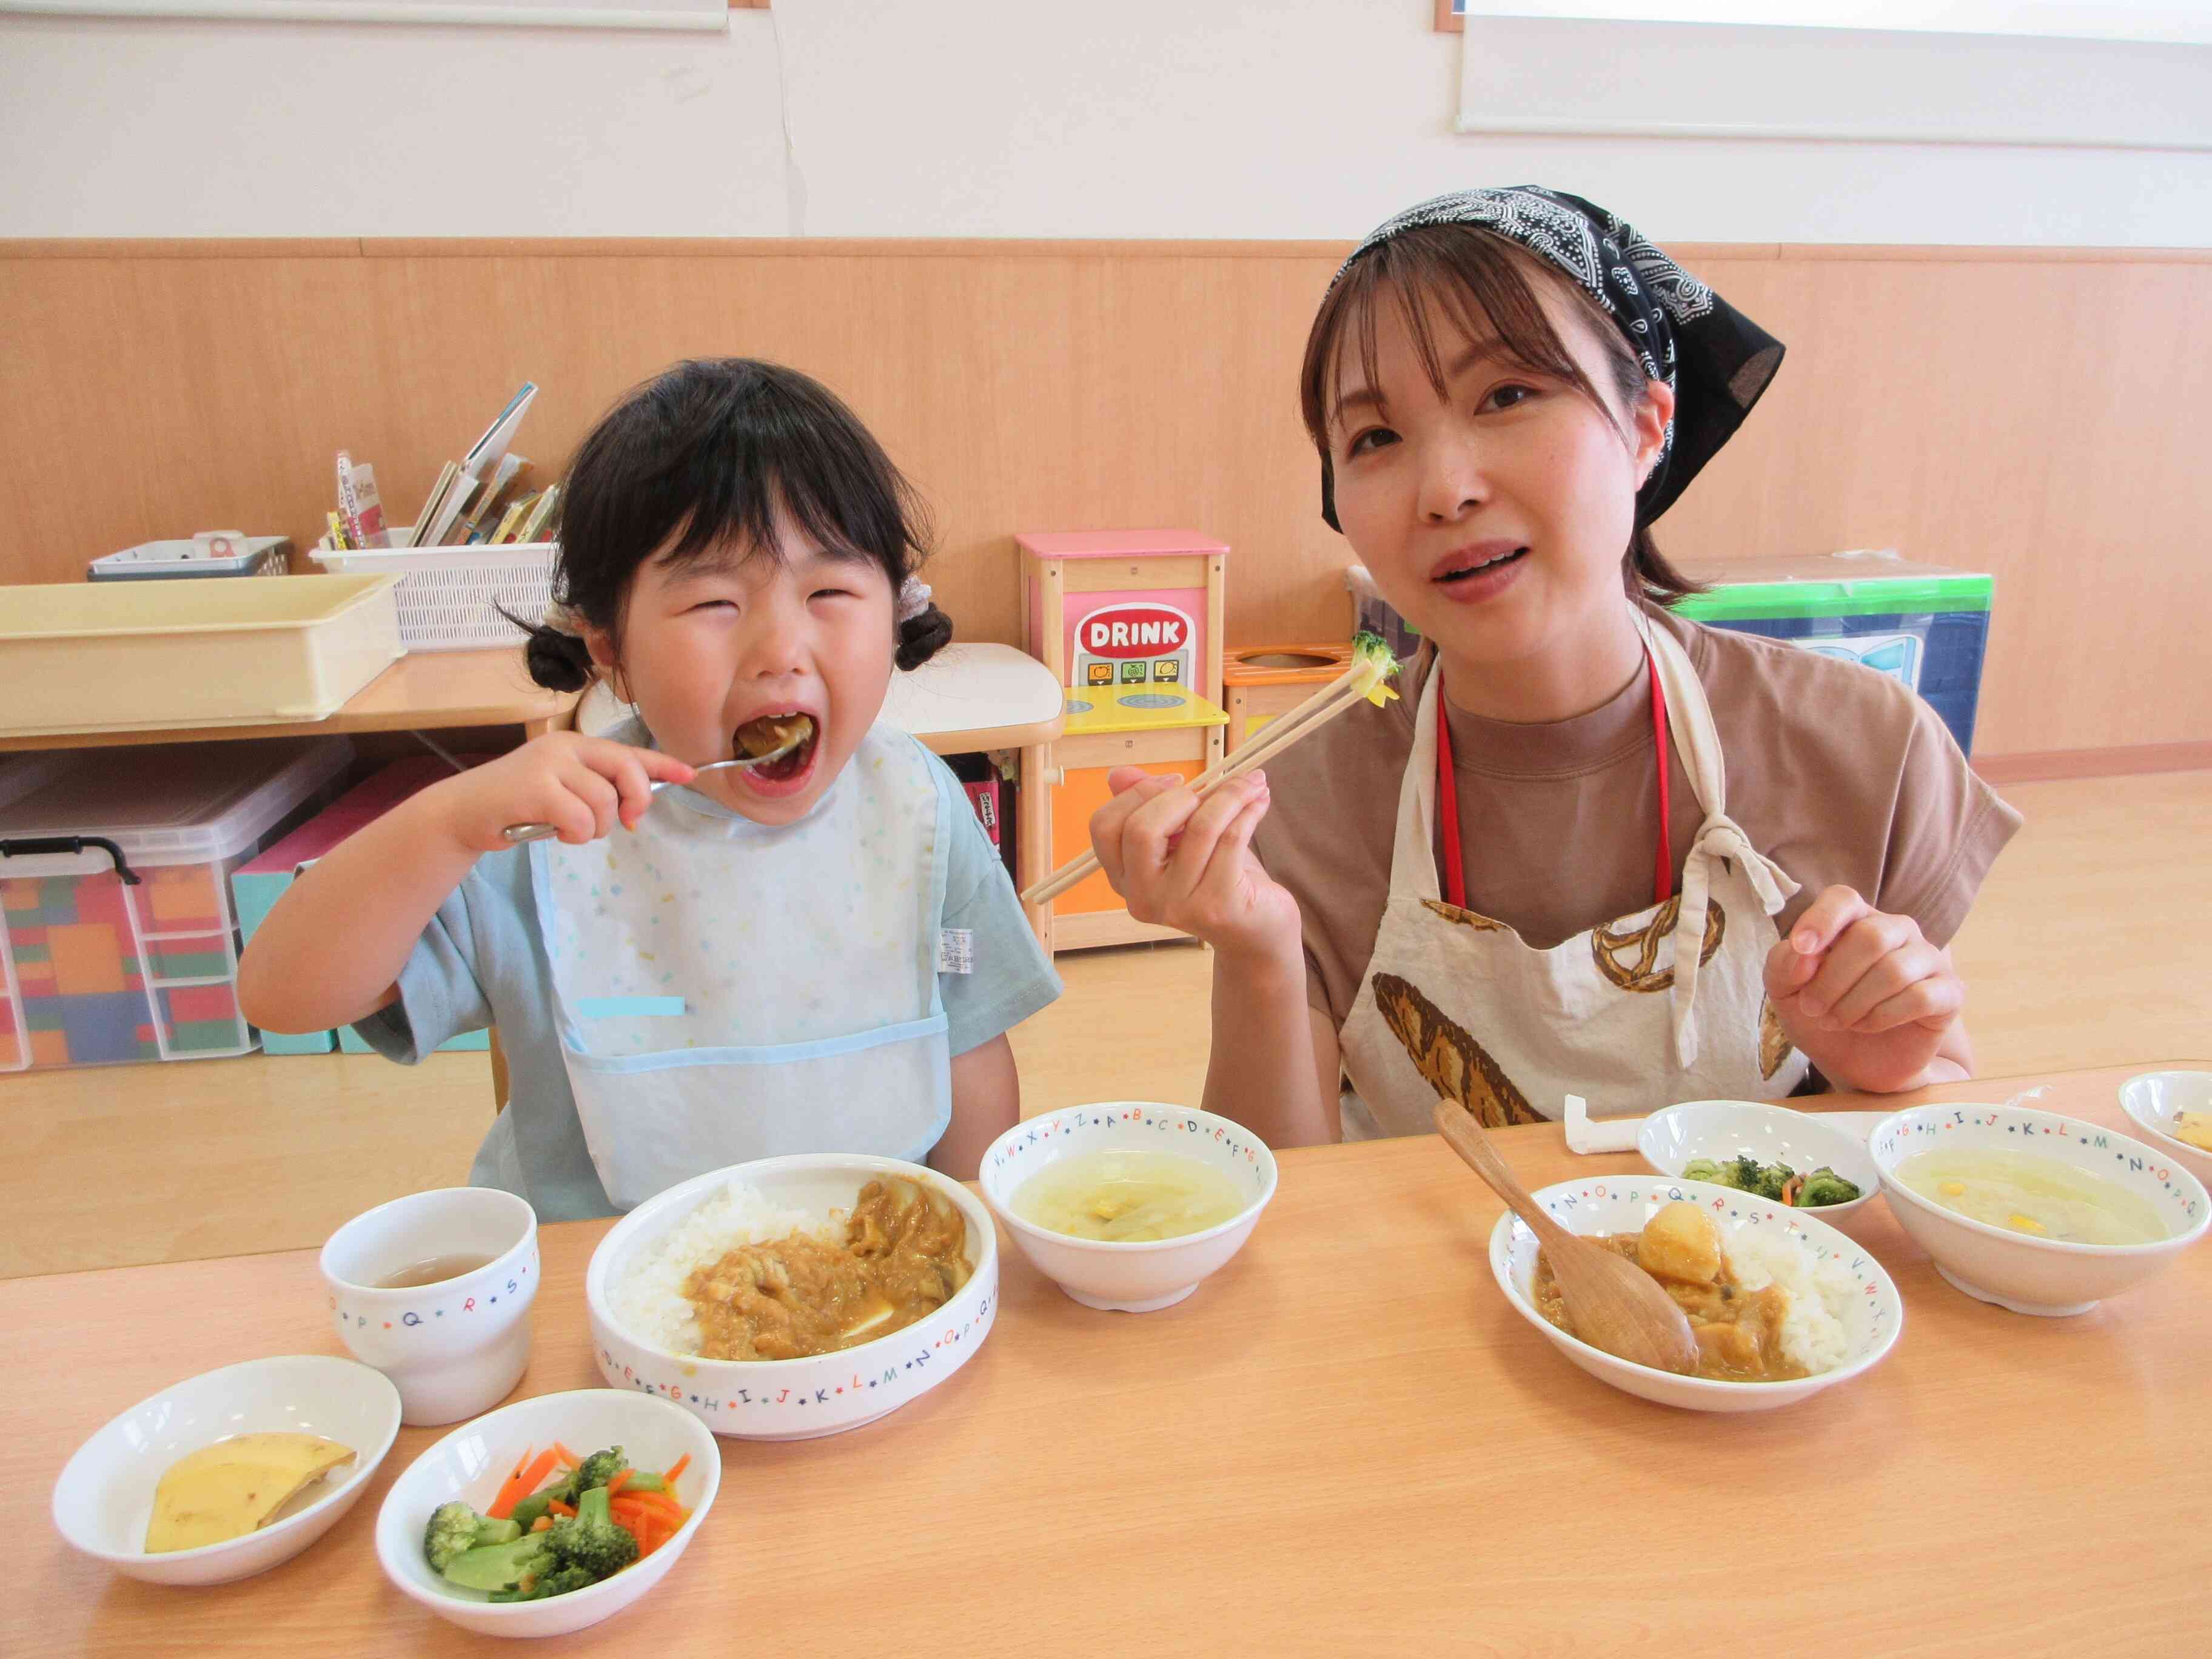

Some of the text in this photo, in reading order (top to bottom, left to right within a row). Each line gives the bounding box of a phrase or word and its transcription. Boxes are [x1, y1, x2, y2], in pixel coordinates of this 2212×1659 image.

[1091, 622, 1180, 647] DRINK
[1007, 1145, 1014, 1157] W
[1027, 1131, 1037, 1145] X
[1053, 1121, 1061, 1131] Y
[1074, 1113, 1087, 1127] Z
[1107, 1116, 1116, 1128] A
[1133, 1108, 1141, 1120] B
[1158, 1119, 1168, 1130] C
[1187, 1121, 1197, 1132] D
[1215, 1128, 1224, 1141] E
[1233, 1145, 1238, 1157] F
[1248, 1150, 1255, 1162] G
[1901, 1124, 1909, 1136] G
[1926, 1123, 1936, 1135] H
[1954, 1111, 1963, 1124] I
[1986, 1114, 1998, 1126] J
[2023, 1123, 2034, 1135] K
[2059, 1124, 2068, 1136] L
[2094, 1136, 2107, 1148] M
[2130, 1158, 2142, 1170] N
[2157, 1169, 2170, 1181] O
[1564, 1195, 1577, 1209] N
[1595, 1185, 1606, 1198] O
[1631, 1191, 1638, 1203] P
[1668, 1188, 1684, 1201] Q
[1712, 1198, 1724, 1211] R
[1750, 1213, 1759, 1224] S
[1785, 1221, 1798, 1235] T
[1852, 1258, 1865, 1269] V
[403, 1312, 423, 1326] Q
[463, 1298, 475, 1312] R
[508, 1279, 517, 1293] S
[670, 1386, 682, 1399] G
[704, 1397, 718, 1411] H
[739, 1389, 751, 1403] I
[777, 1389, 790, 1403] J
[816, 1389, 829, 1403] K
[853, 1375, 862, 1389] L
[883, 1367, 897, 1383] M
[944, 1329, 954, 1344] O
[964, 1323, 970, 1337] P
[980, 1300, 988, 1315] Q
